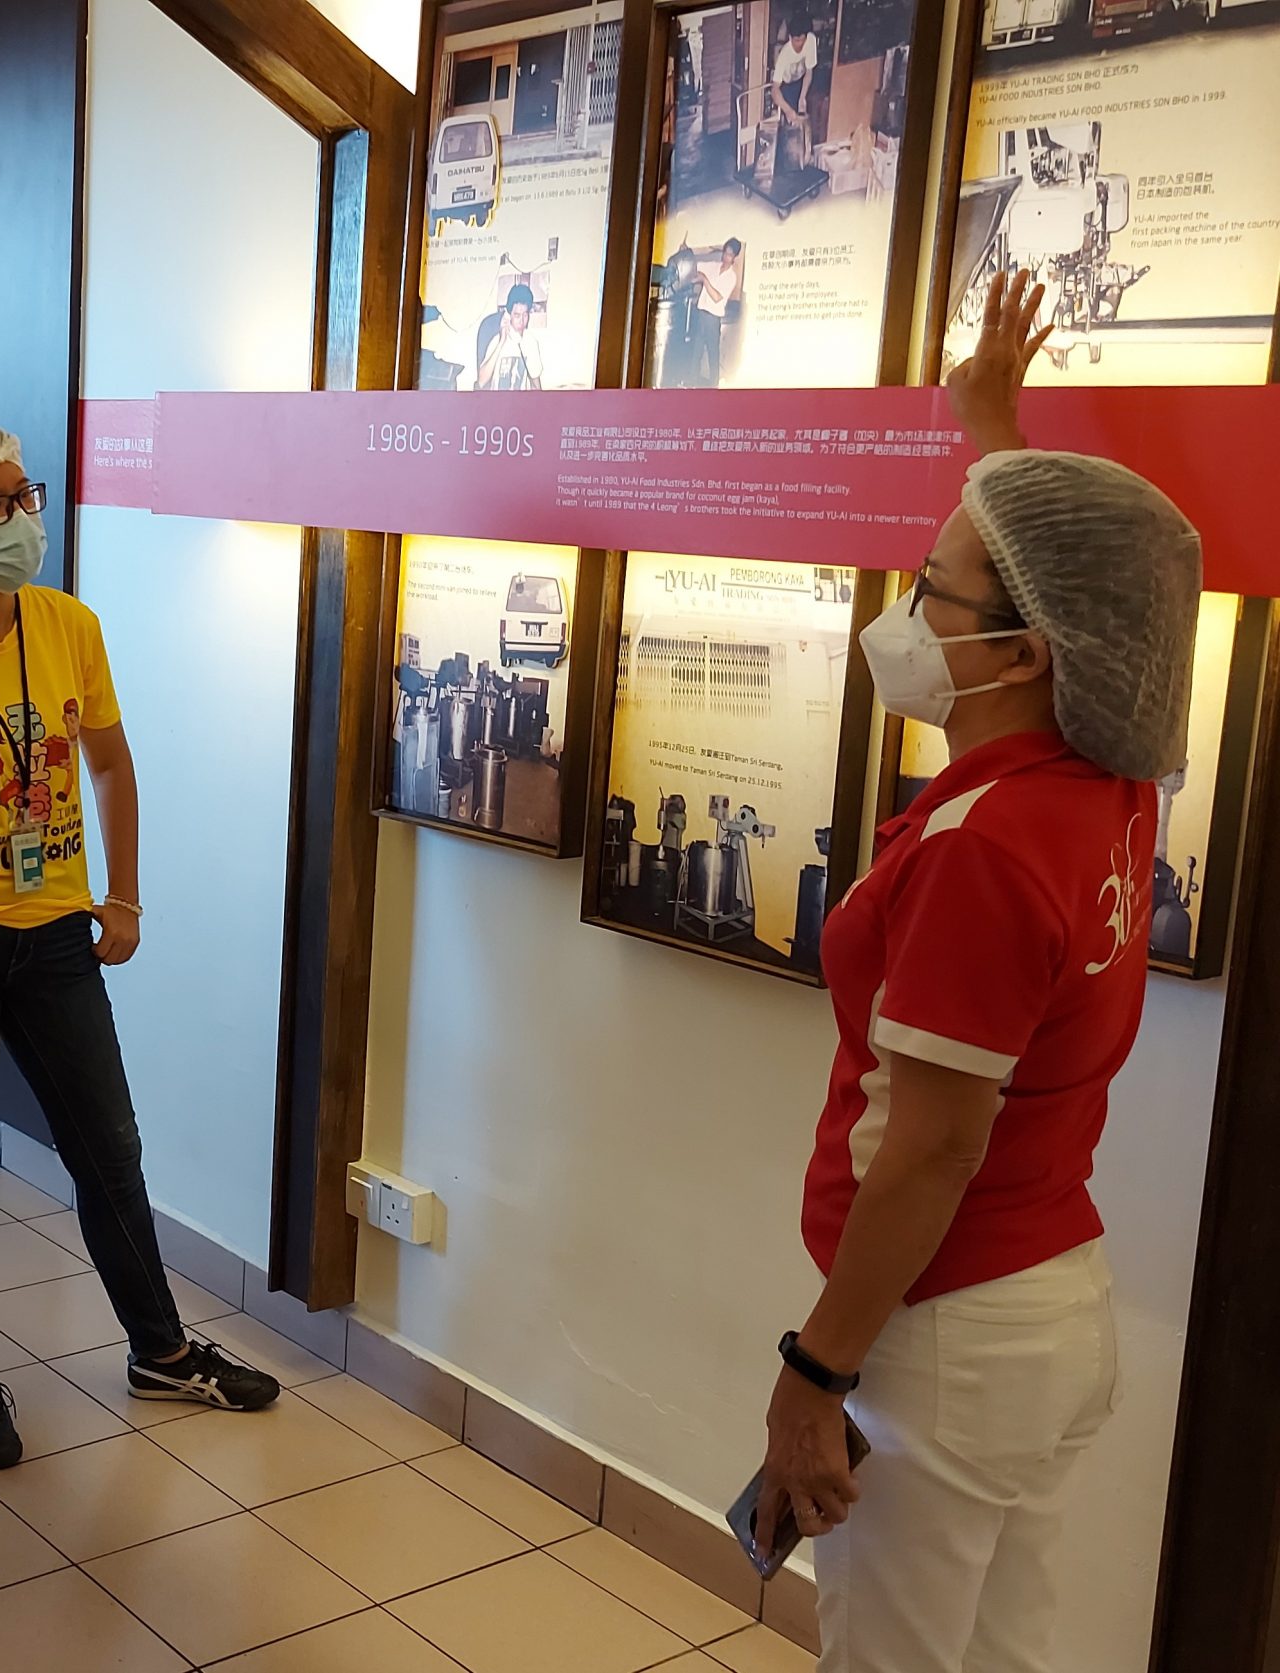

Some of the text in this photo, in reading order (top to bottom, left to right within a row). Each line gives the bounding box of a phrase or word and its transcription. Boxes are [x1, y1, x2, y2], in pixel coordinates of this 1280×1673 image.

[999, 92, 1019, 102] FOOD
[1021, 86, 1064, 100] INDUSTRIES
[997, 114, 1026, 126] officially
[1028, 111, 1057, 122] became
[1059, 108, 1079, 119] YU-AI
[1081, 106, 1102, 116] FOOD
[1105, 99, 1151, 113] INDUSTRIES
[1192, 94, 1200, 103] in
[1134, 211, 1209, 224] YU-AI imported the
[1132, 227, 1148, 236] first
[1150, 225, 1180, 236] packing
[1182, 222, 1216, 232] machine
[1219, 221, 1228, 231] of
[1231, 220, 1244, 230] the
[1130, 239, 1149, 248] from
[1150, 238, 1172, 248] Japan
[1174, 237, 1182, 246] in
[1184, 236, 1198, 246] the
[1200, 236, 1222, 245] same
[366, 424, 435, 454] 1980s
[458, 426, 535, 458] 1990s
[558, 474, 592, 484] Established
[593, 476, 599, 484] in
[621, 477, 639, 486] YU-AI
[640, 477, 656, 487] Food
[657, 478, 690, 488] Industries
[724, 480, 740, 490] first
[741, 481, 762, 492] began
[764, 483, 773, 492] as
[774, 484, 780, 492] a
[782, 482, 798, 492] food
[800, 483, 822, 495] filling
[558, 486, 579, 496] Though
[586, 488, 608, 498] quickly
[610, 488, 634, 498] became
[640, 490, 664, 500] popular
[666, 490, 684, 500] brand
[686, 491, 696, 500] for
[698, 492, 726, 502] coconut
[727, 495, 740, 504] egg
[741, 494, 754, 504] jam
[588, 499, 603, 508] until
[624, 500, 636, 510] that
[638, 502, 649, 510] the
[651, 502, 655, 510] 4
[690, 504, 720, 514] brothers
[721, 506, 737, 516] took
[740, 506, 752, 516] the
[787, 510, 795, 518] to
[797, 510, 824, 520] expand
[826, 511, 848, 520] YU-AI
[850, 512, 866, 522] into
[868, 514, 872, 522] a
[874, 515, 900, 524] newer
[730, 568, 805, 586] PEMBORONG KAYA
[722, 587, 764, 601] TRADING
[649, 759, 664, 767] YU-AI
[664, 762, 682, 771] moved
[683, 764, 689, 773] to
[690, 766, 707, 776] Taman
[708, 769, 716, 778] Sri
[716, 770, 738, 783] Serdang
